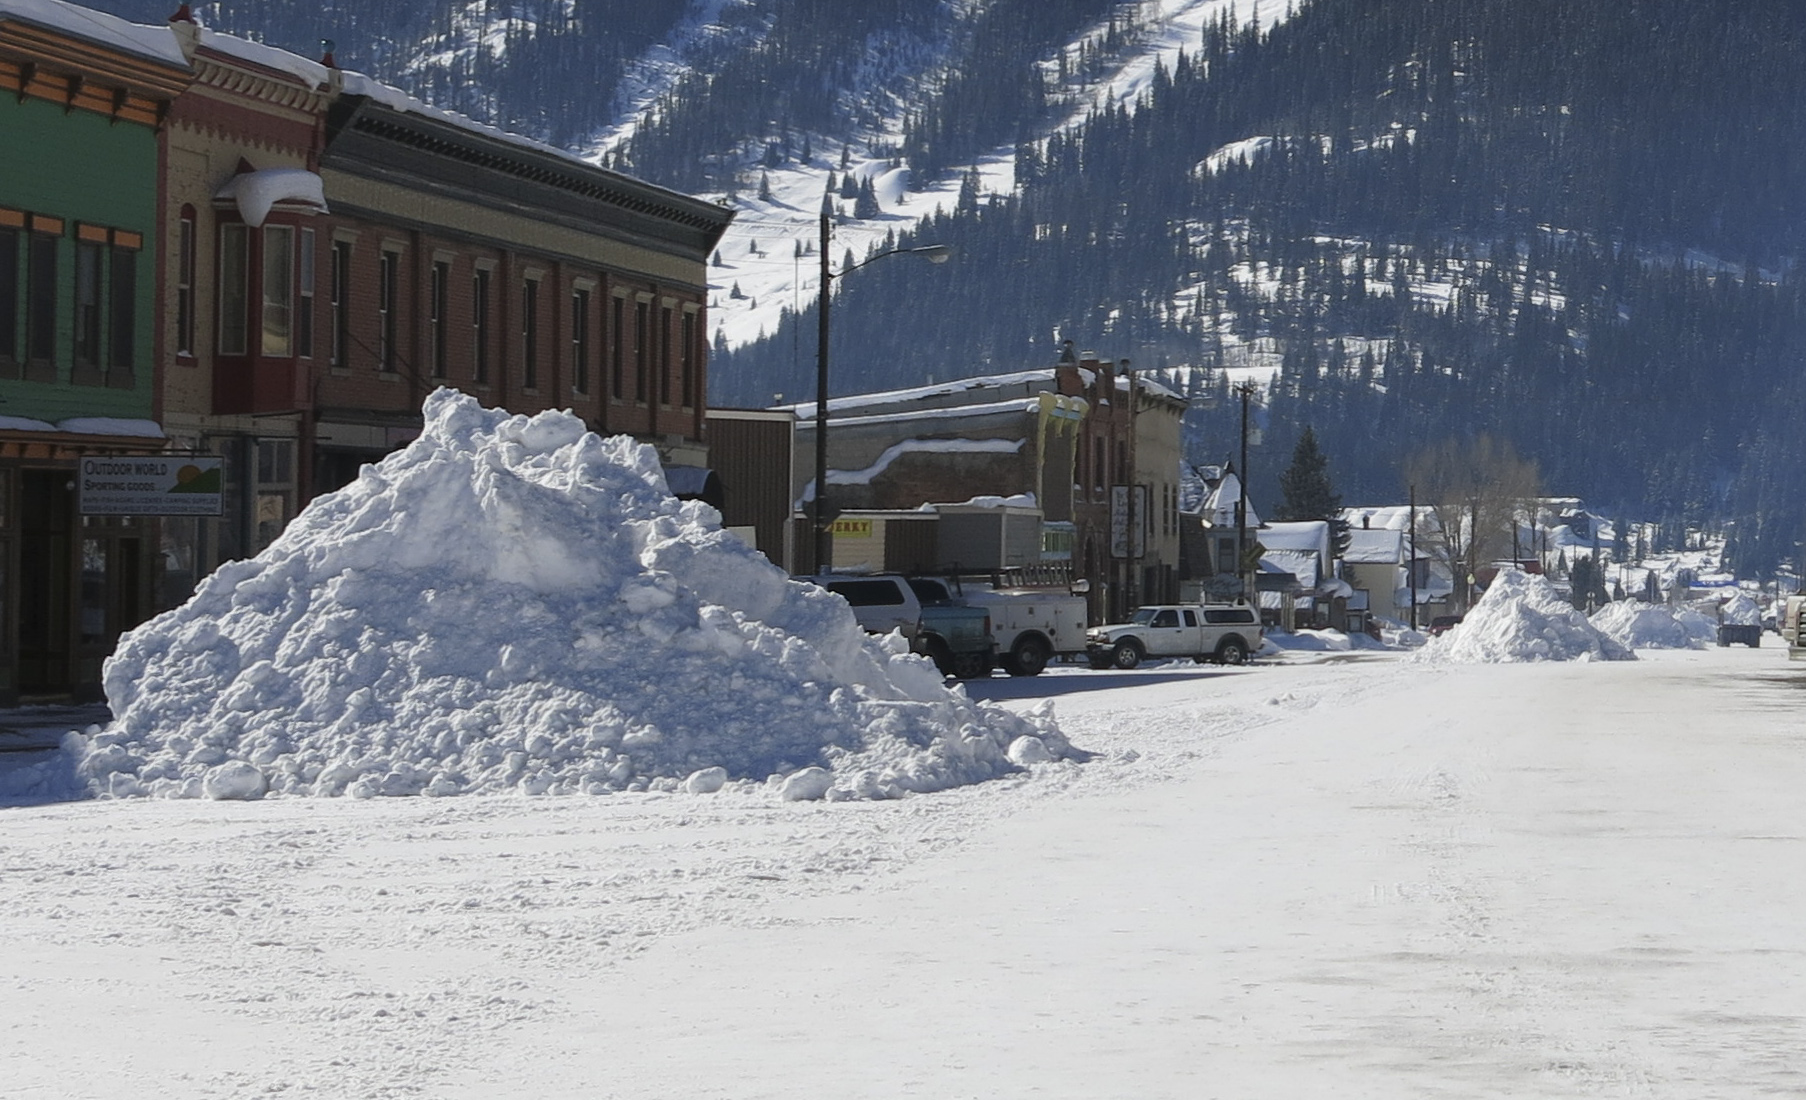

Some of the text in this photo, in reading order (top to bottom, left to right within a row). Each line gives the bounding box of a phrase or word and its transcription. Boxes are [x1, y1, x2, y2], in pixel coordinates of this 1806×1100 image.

[84, 460, 168, 475] OUTDOOR WORLD
[84, 479, 125, 491] SPORTING
